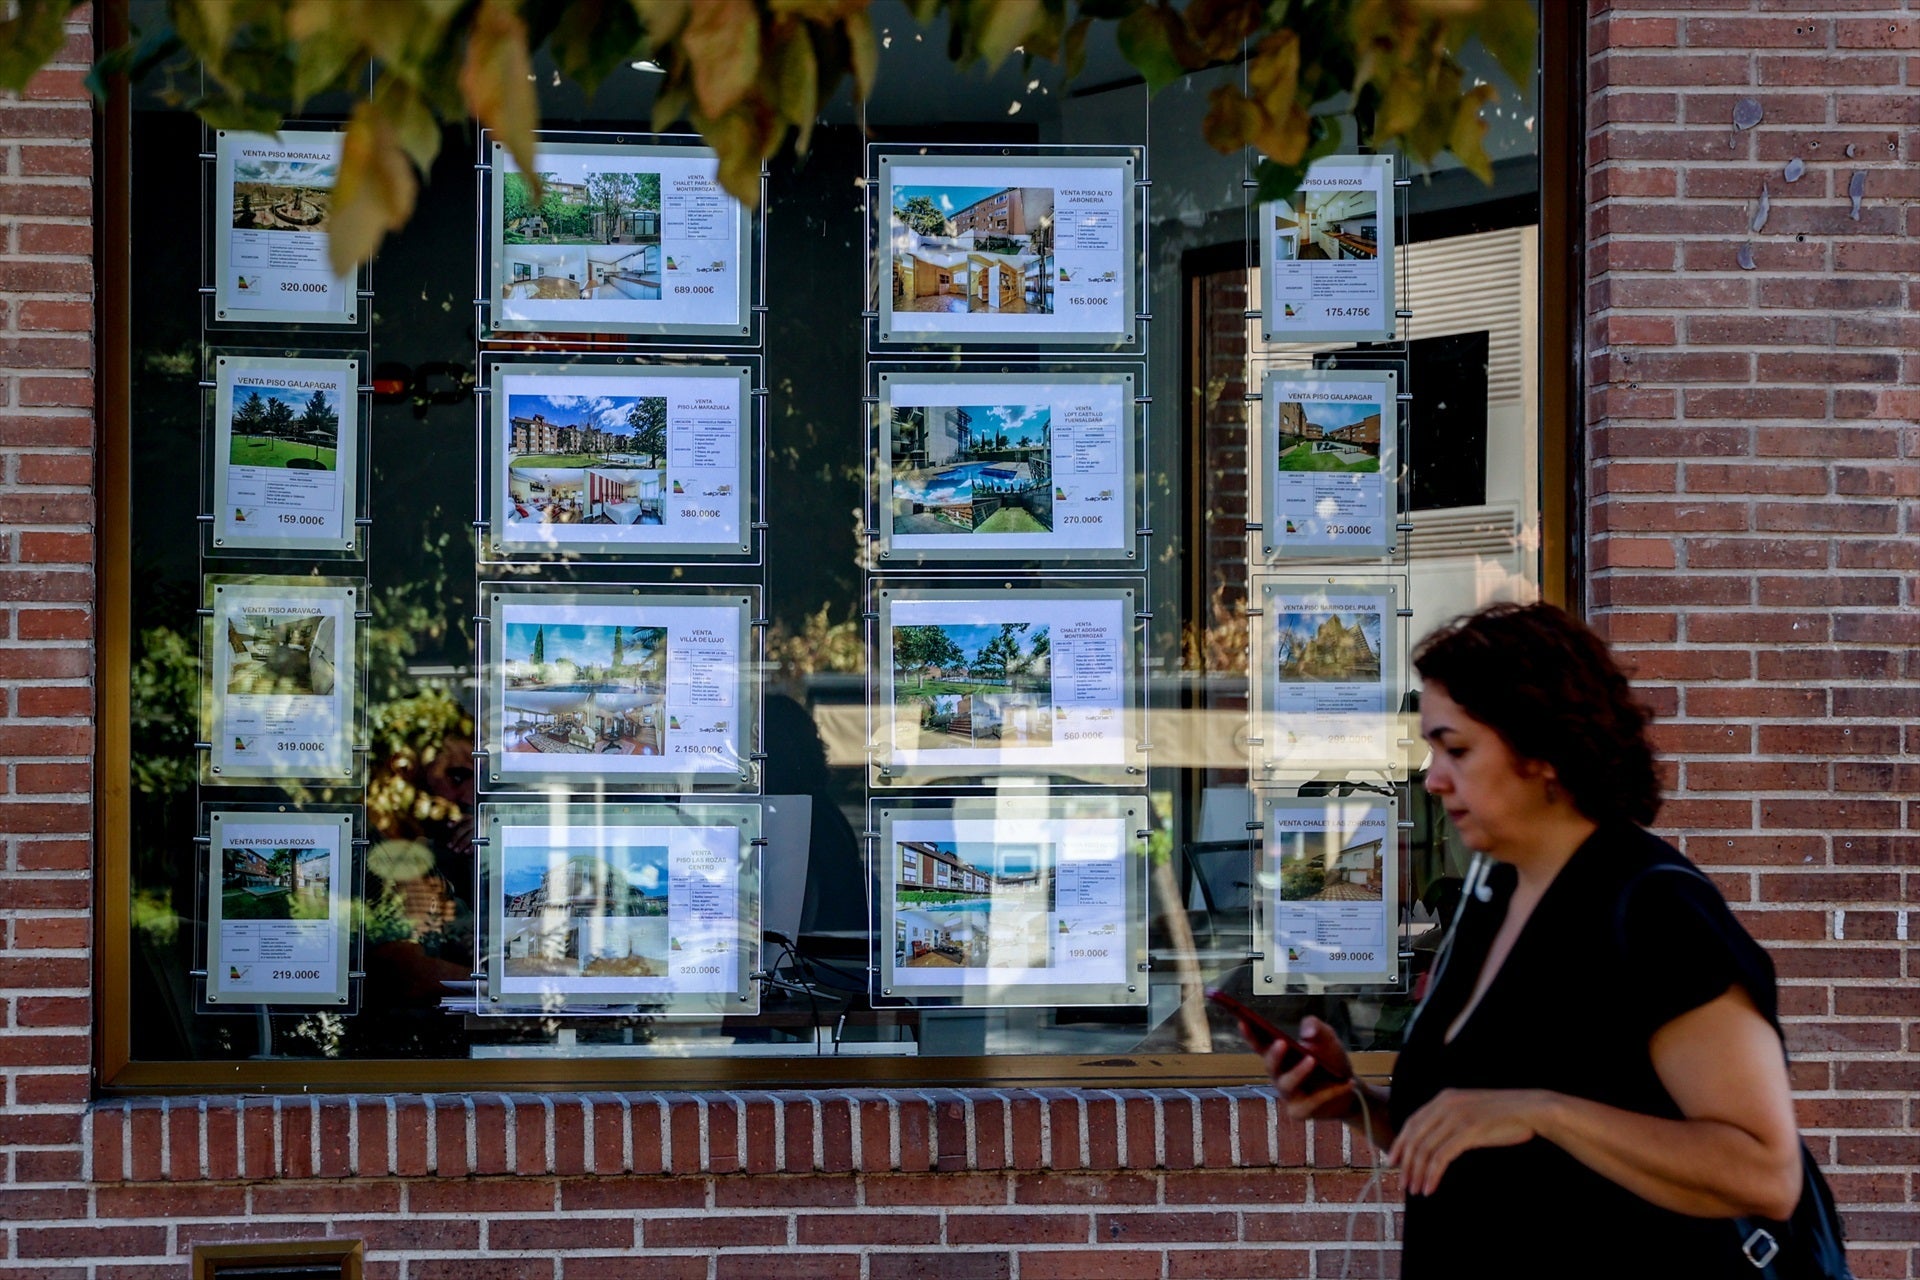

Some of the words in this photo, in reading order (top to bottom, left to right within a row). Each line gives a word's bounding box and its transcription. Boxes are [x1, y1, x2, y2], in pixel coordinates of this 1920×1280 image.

[242, 150, 266, 158] VENTA
[268, 151, 285, 159] PISO
[287, 152, 331, 160] MORATALAZ
[280, 282, 328, 293] 320.000€
[674, 286, 714, 294] 689.000€
[1070, 297, 1109, 305] 165.000€
[1326, 307, 1370, 317] 175.475€
[238, 377, 264, 386] VENTA
[266, 378, 286, 387] PISO
[288, 380, 337, 390] GALAPAGAR
[680, 509, 721, 518] 380.000€
[278, 514, 325, 526] 159.000€
[1063, 516, 1103, 524] 270.000€
[1326, 525, 1372, 535] 205.000€
[242, 606, 267, 614] VENTA
[286, 607, 322, 615] ARAVACA
[277, 741, 325, 752] 319.000€
[675, 745, 723, 754] 2.150.000€
[255, 838, 273, 846] PISO
[274, 838, 289, 846] LAS
[290, 838, 316, 846] ROZAS
[1069, 949, 1109, 957] 199.000€
[1329, 952, 1374, 961] 399.000€
[680, 966, 721, 974] 320.000€
[272, 970, 320, 980] 219.000€
